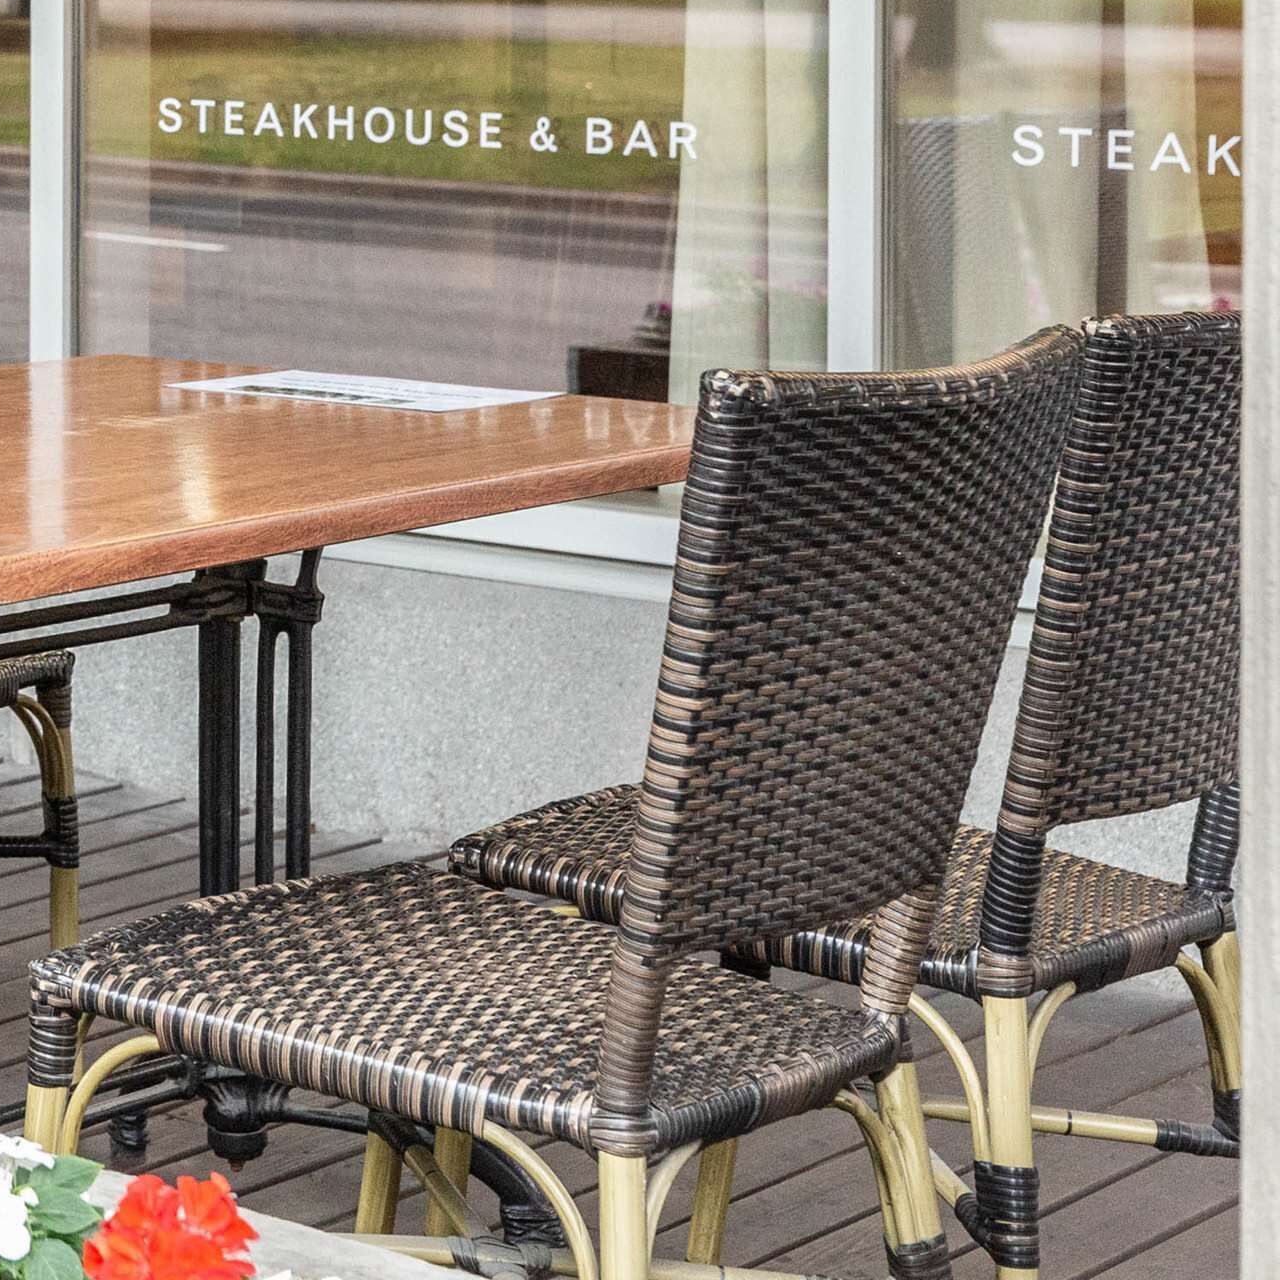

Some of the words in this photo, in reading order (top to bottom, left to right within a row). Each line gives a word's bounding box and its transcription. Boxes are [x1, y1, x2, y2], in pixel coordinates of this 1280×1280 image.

[157, 96, 503, 150] STEAKHOUSE
[529, 116, 559, 153] &
[586, 117, 700, 160] BAR
